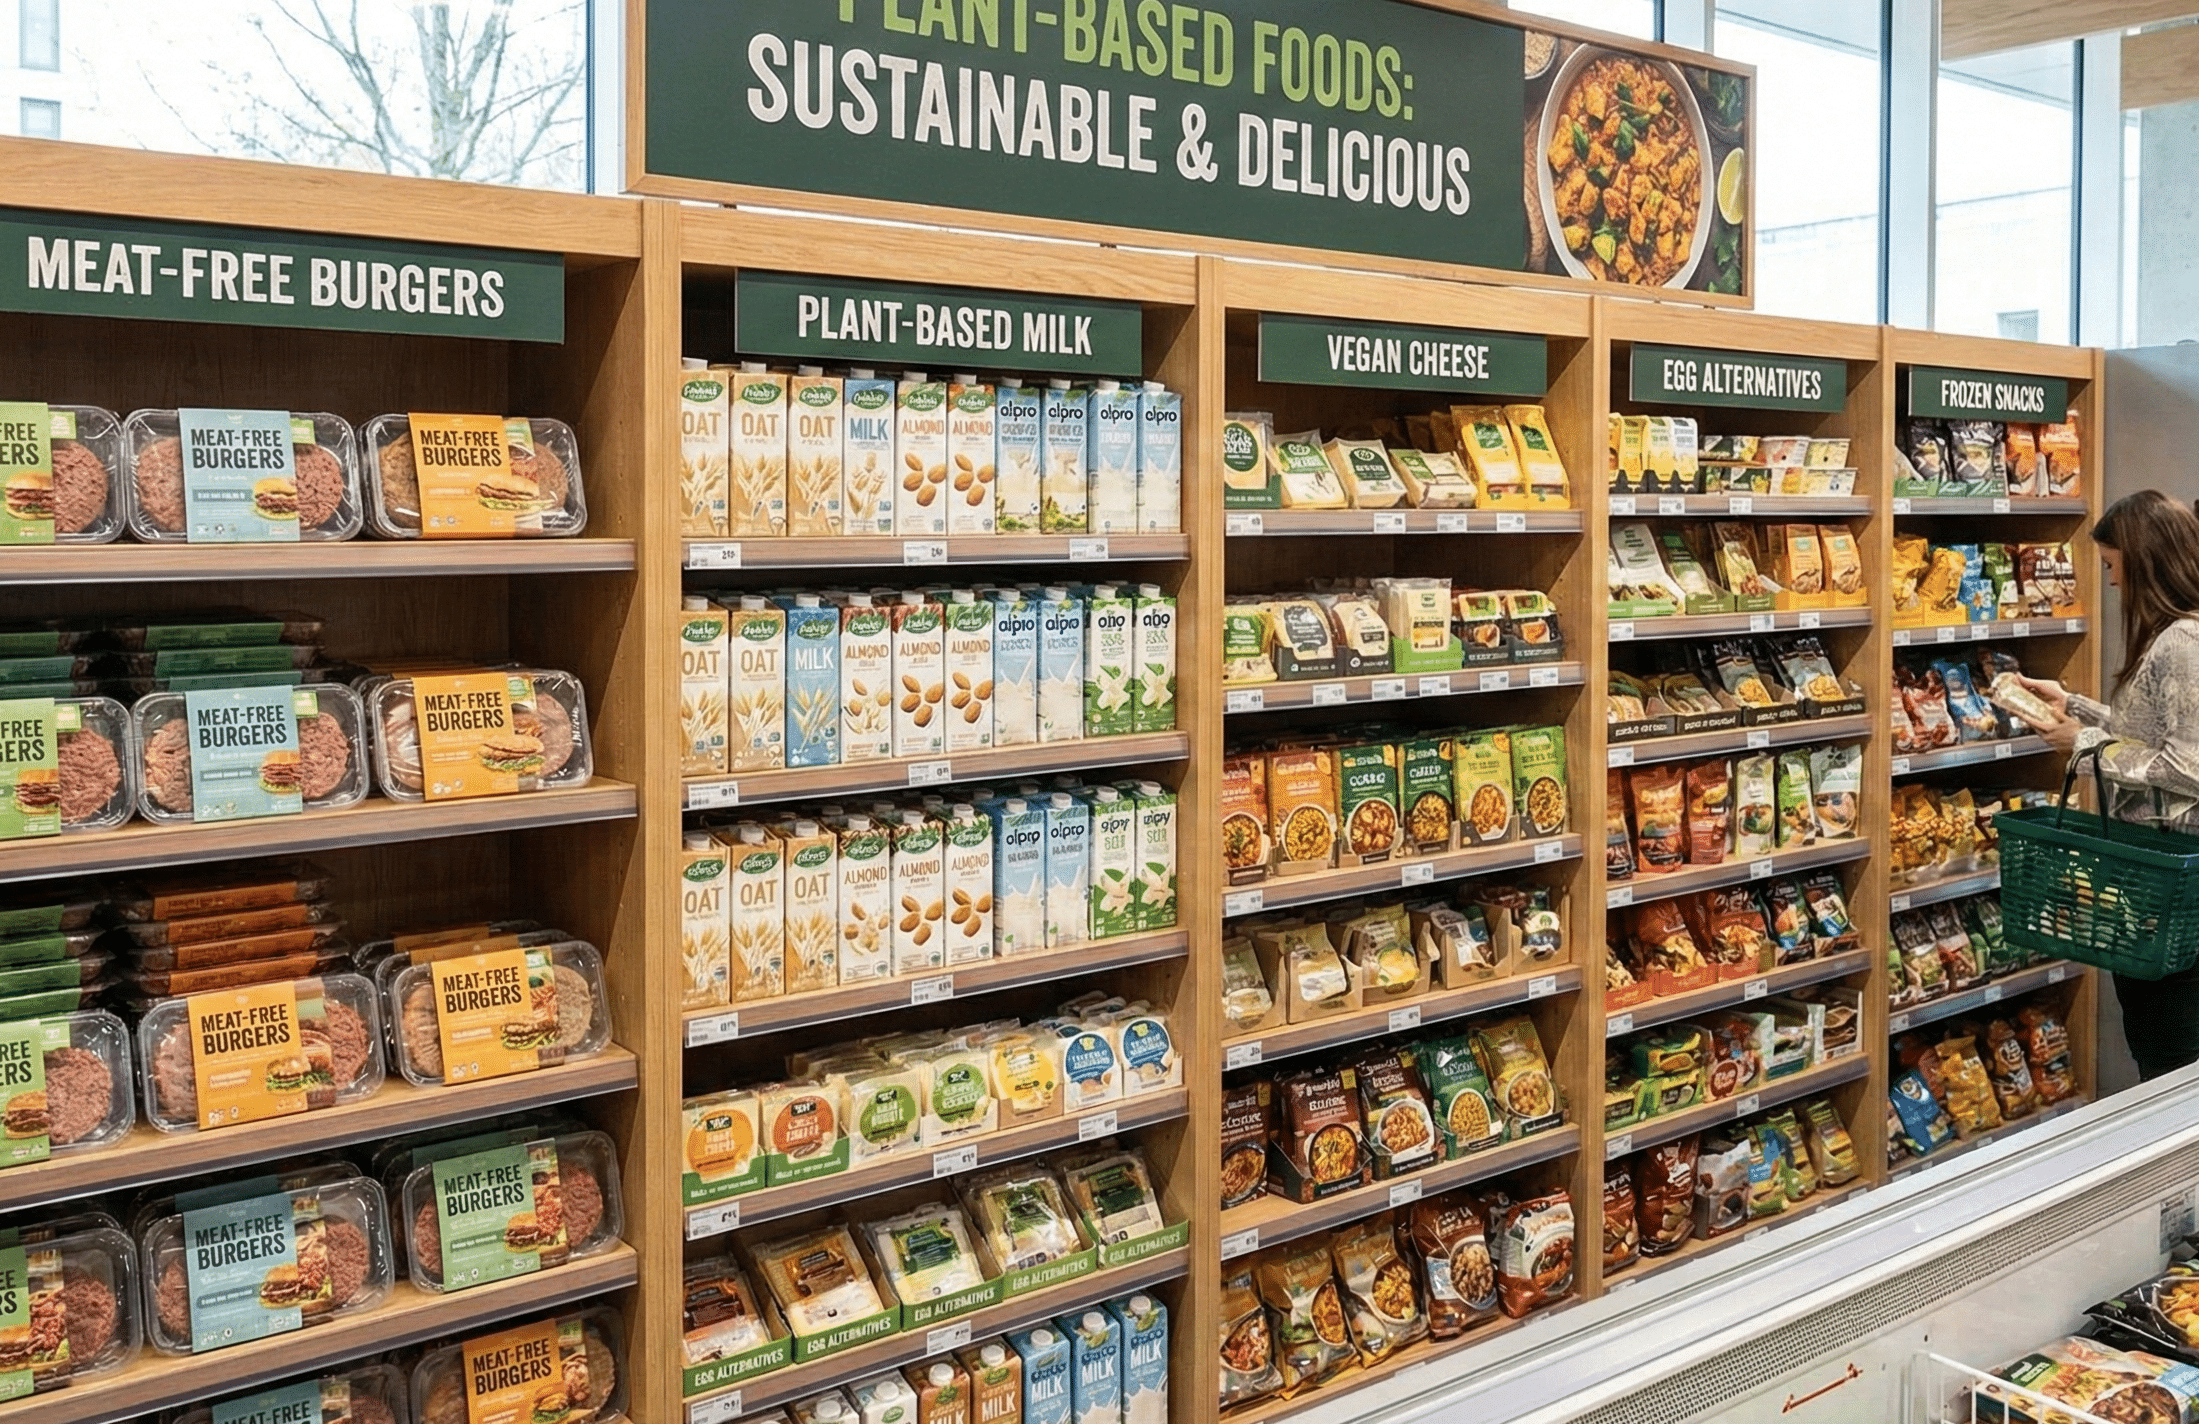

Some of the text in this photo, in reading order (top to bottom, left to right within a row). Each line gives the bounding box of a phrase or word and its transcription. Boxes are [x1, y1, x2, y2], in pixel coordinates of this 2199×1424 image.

[1253, 20, 1413, 121] FOODS:
[747, 33, 1471, 215] SUSTAINABLE & DELICIOUS
[28, 236, 505, 318] MEAT-FREE BURGERS
[798, 294, 1092, 356] PLANT-BASED MILK
[1327, 334, 1489, 379] VEGAN CHEESE
[1663, 359, 1822, 400] EGG ALTERNATIVES
[1941, 379, 2045, 413] FROZEN SNACKS
[191, 428, 282, 447] MEAT-FREE
[682, 412, 721, 436] OAT
[741, 413, 779, 438] OAT
[799, 415, 835, 438] OAT
[850, 418, 889, 441] MILK
[420, 429, 499, 448] MEAT-FREE
[192, 447, 284, 470] BURGERS
[422, 447, 502, 469] BURGERS
[682, 650, 720, 675] OAT
[741, 649, 778, 674] OAT
[795, 646, 834, 671] MILK
[424, 690, 502, 712] MEAT-FREE
[197, 705, 286, 728] MEAT-FREE
[427, 708, 505, 732] BURGERS
[199, 723, 288, 749] BURGERS
[794, 872, 831, 899] OAT
[844, 866, 887, 885] ALMOND
[684, 886, 724, 914] OAT
[740, 879, 778, 906] OAT
[443, 966, 520, 993] MEAT-FREE
[445, 984, 522, 1013] BURGERS
[201, 1003, 288, 1034] MEAT-FREE
[203, 1023, 291, 1055] BURGERS
[443, 1164, 523, 1195] MEAT-FREE
[446, 1183, 525, 1217] BURGERS
[195, 1213, 285, 1247] MEAT-FREE
[197, 1233, 286, 1270] BURGERS
[472, 1338, 551, 1374] MEAT-FREE
[1131, 1339, 1162, 1369] MILK
[475, 1356, 552, 1395] BURGERS
[1081, 1356, 1115, 1388] MILK
[1031, 1375, 1063, 1405] MILK
[981, 1391, 1016, 1422] MILK
